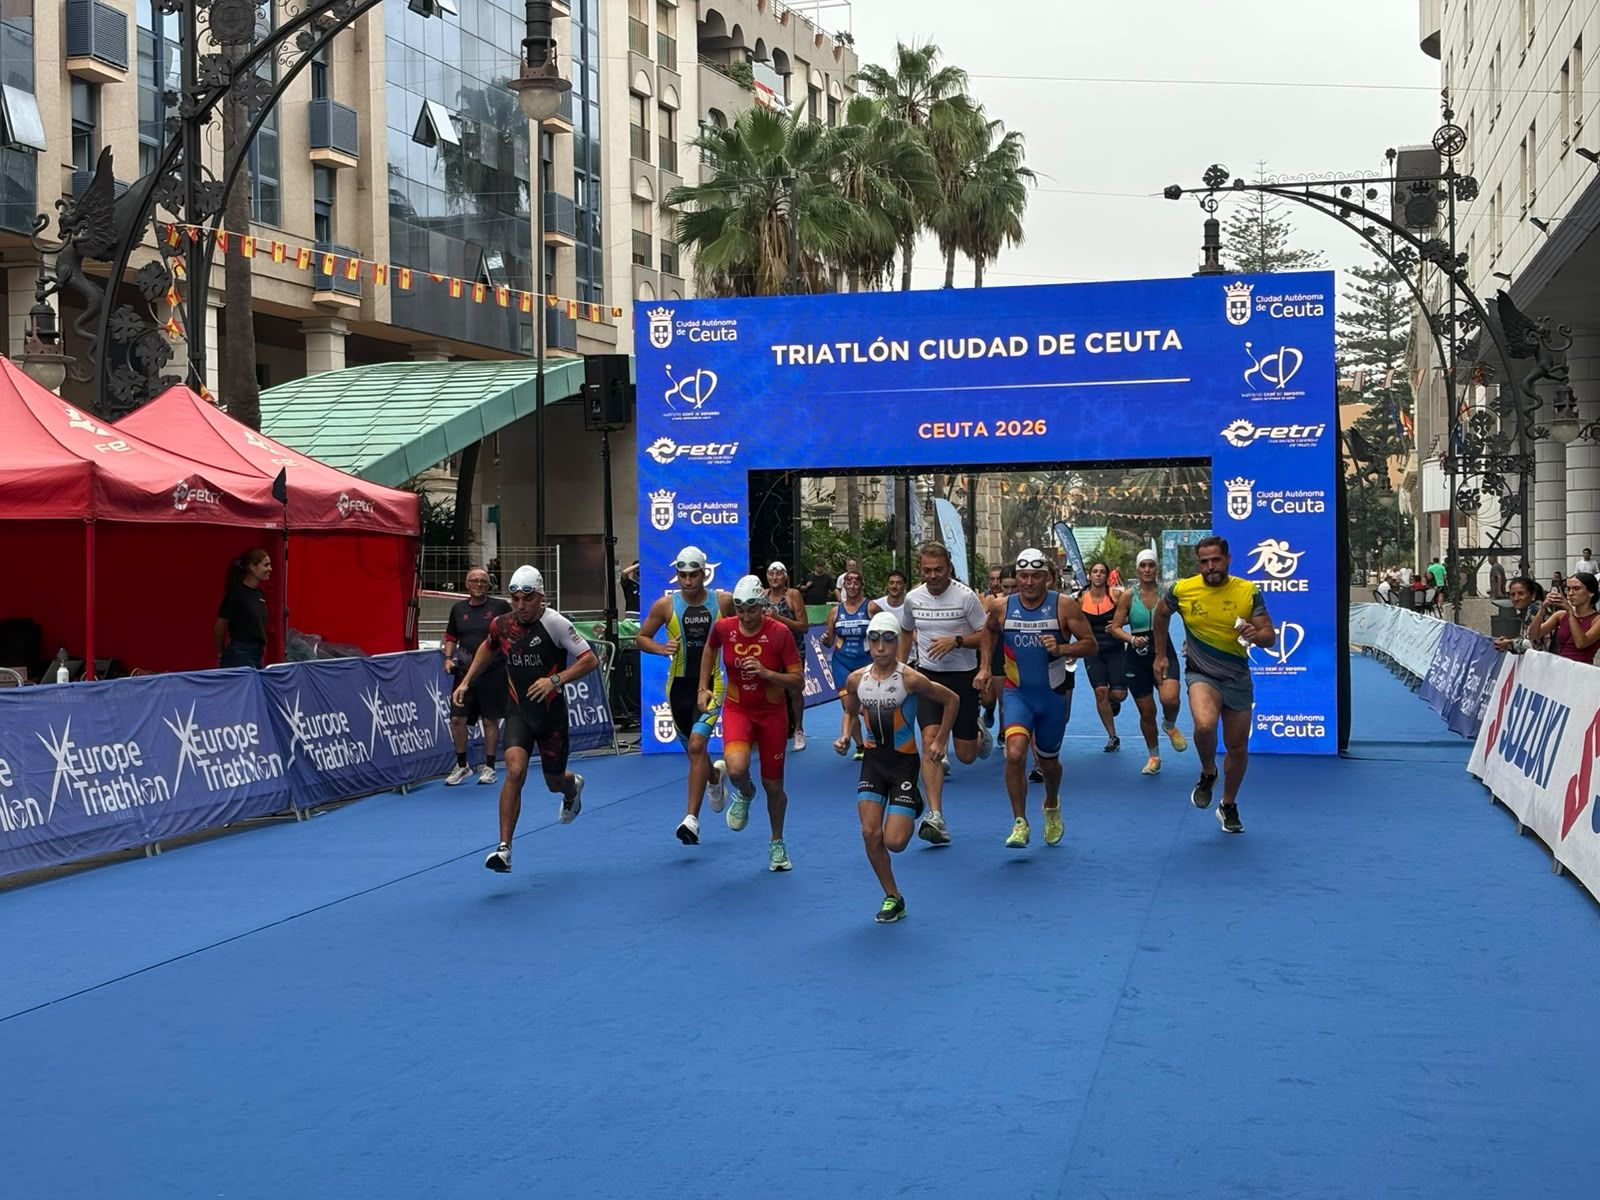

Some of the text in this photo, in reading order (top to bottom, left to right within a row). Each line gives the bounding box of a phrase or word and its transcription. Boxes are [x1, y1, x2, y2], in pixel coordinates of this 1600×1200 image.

[1256, 293, 1324, 303] Ciudad Autónoma
[1270, 302, 1324, 318] Ceuta
[676, 319, 737, 328] Ciudad Autónoma
[690, 327, 737, 342] Ceuta
[771, 329, 1183, 366] TRIATLÓN CIUDAD DE CEUTA
[918, 420, 1047, 439] CEUTA 2026
[1257, 489, 1324, 498] Ciudad Autónoma
[703, 501, 738, 509] Autónoma
[1271, 498, 1324, 513] Ceuta
[677, 510, 738, 524] de Ceuta
[684, 615, 710, 625] DURAN
[377, 700, 418, 727] Europe
[1257, 713, 1325, 722] Ciudad Autónoma
[296, 711, 350, 740] Europe
[1257, 722, 1325, 738] de Ceuta
[190, 722, 260, 755] Europe
[383, 726, 434, 757] Triathlon
[1498, 683, 1571, 790] SUZUKI
[65, 740, 143, 775] Europe
[303, 738, 371, 772] Triathlon
[197, 751, 284, 792] Triathlon
[74, 773, 171, 817] Triathlon
